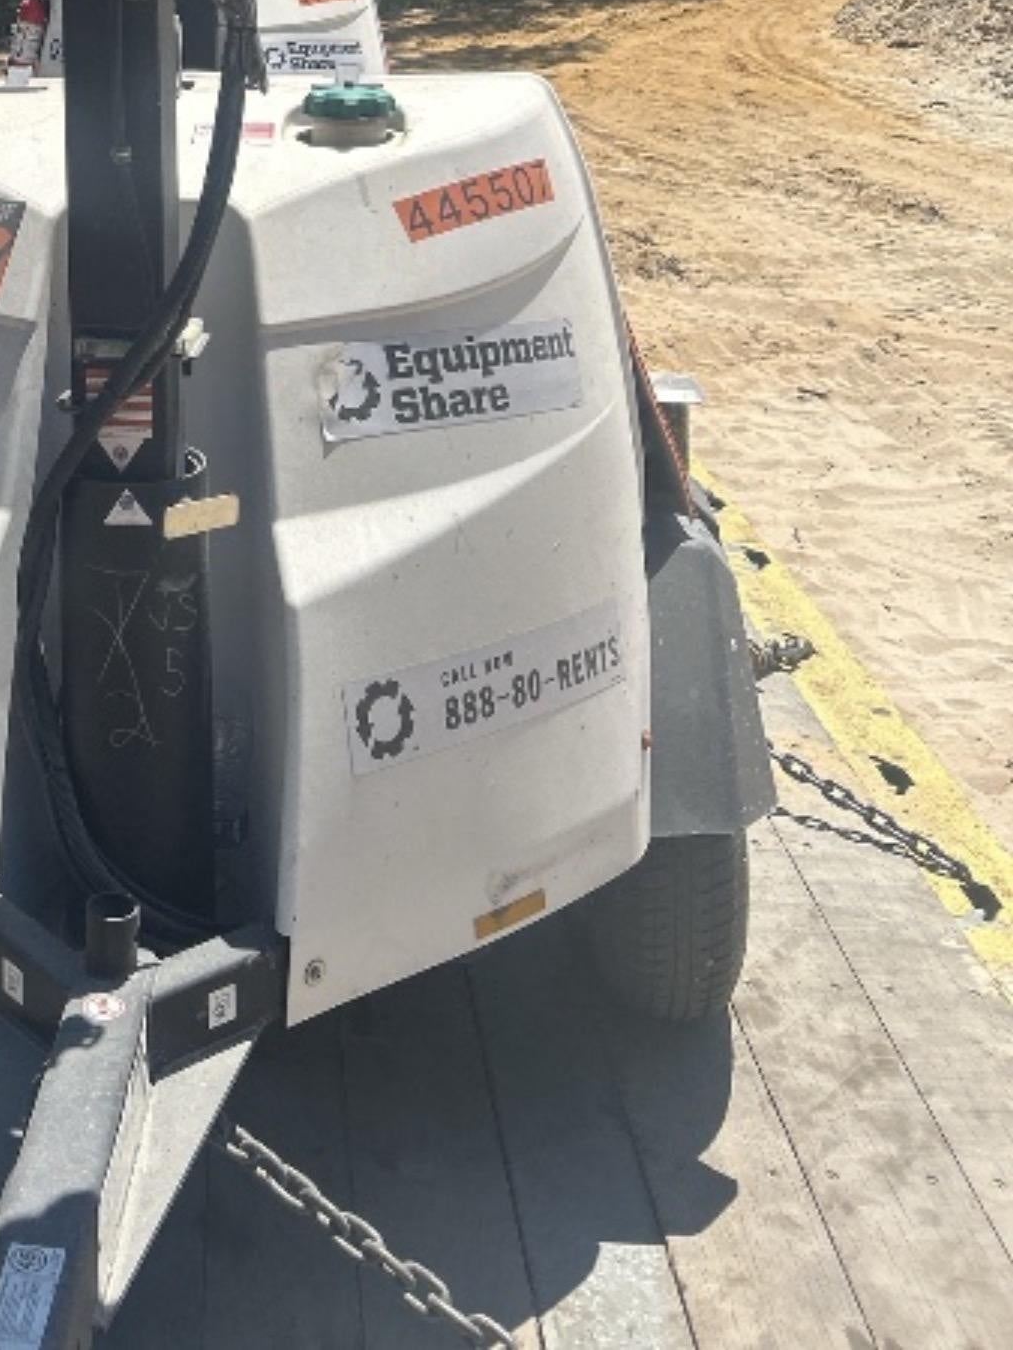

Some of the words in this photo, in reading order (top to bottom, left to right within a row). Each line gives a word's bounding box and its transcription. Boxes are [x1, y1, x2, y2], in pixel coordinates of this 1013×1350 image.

[408, 160, 550, 236] 445507
[384, 326, 576, 384] Equipment
[392, 383, 511, 424] Share
[441, 662, 477, 688] CALL
[445, 635, 621, 730] 888-80-RENTS
